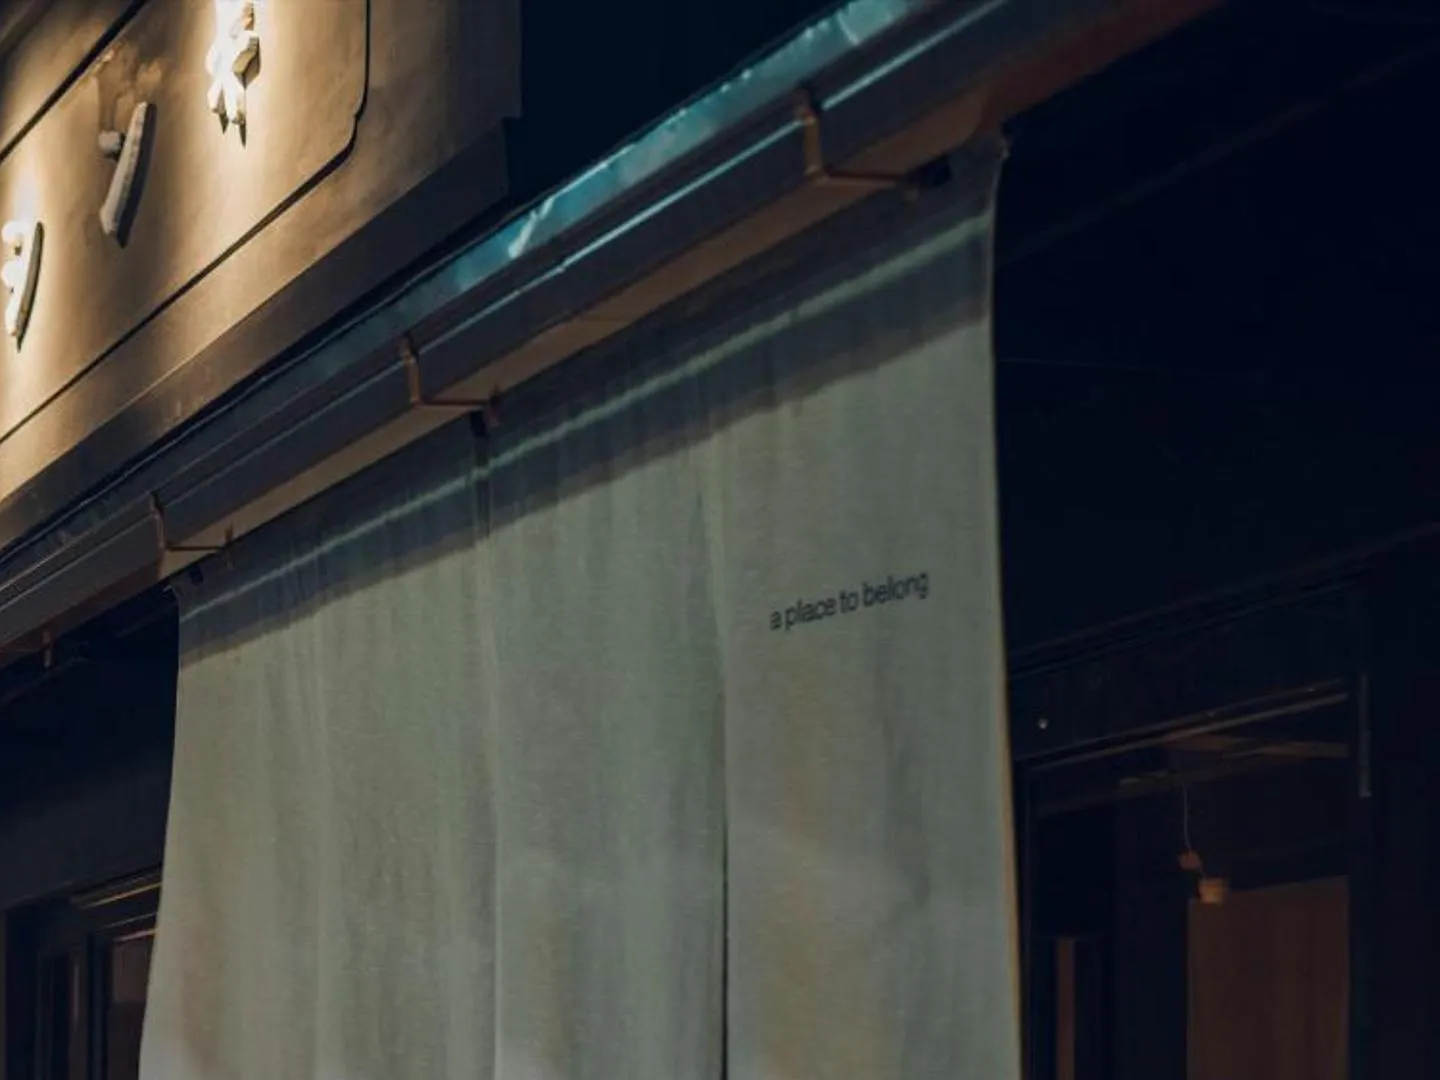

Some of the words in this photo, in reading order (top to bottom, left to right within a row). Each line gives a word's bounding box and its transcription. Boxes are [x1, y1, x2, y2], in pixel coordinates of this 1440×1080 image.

[770, 611, 782, 630] a
[785, 600, 837, 631] place
[839, 590, 859, 614] to
[863, 572, 929, 607] belong
